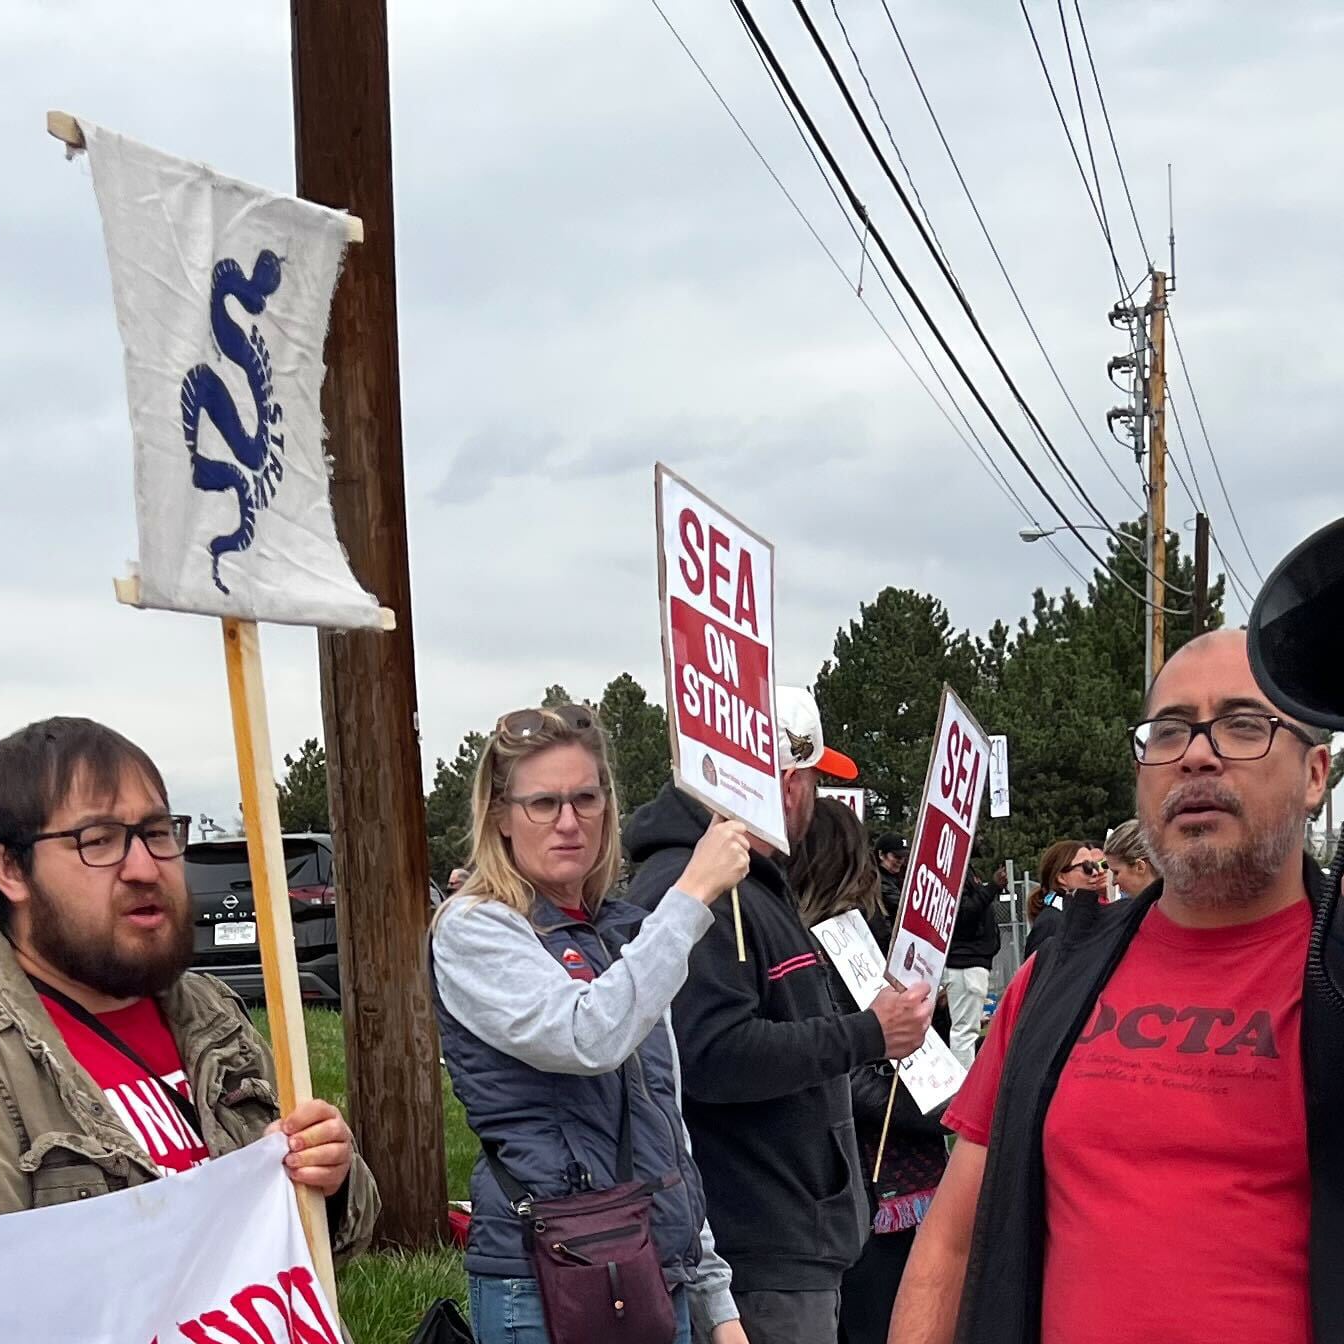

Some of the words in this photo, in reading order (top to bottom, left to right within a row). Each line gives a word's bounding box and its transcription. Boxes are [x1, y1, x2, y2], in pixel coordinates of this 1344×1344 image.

[678, 507, 759, 638] SEA
[704, 623, 739, 689] ON
[682, 663, 771, 766] STRIKE
[941, 720, 980, 828] SEA
[937, 823, 957, 878] ON
[913, 863, 956, 943] STRIKE
